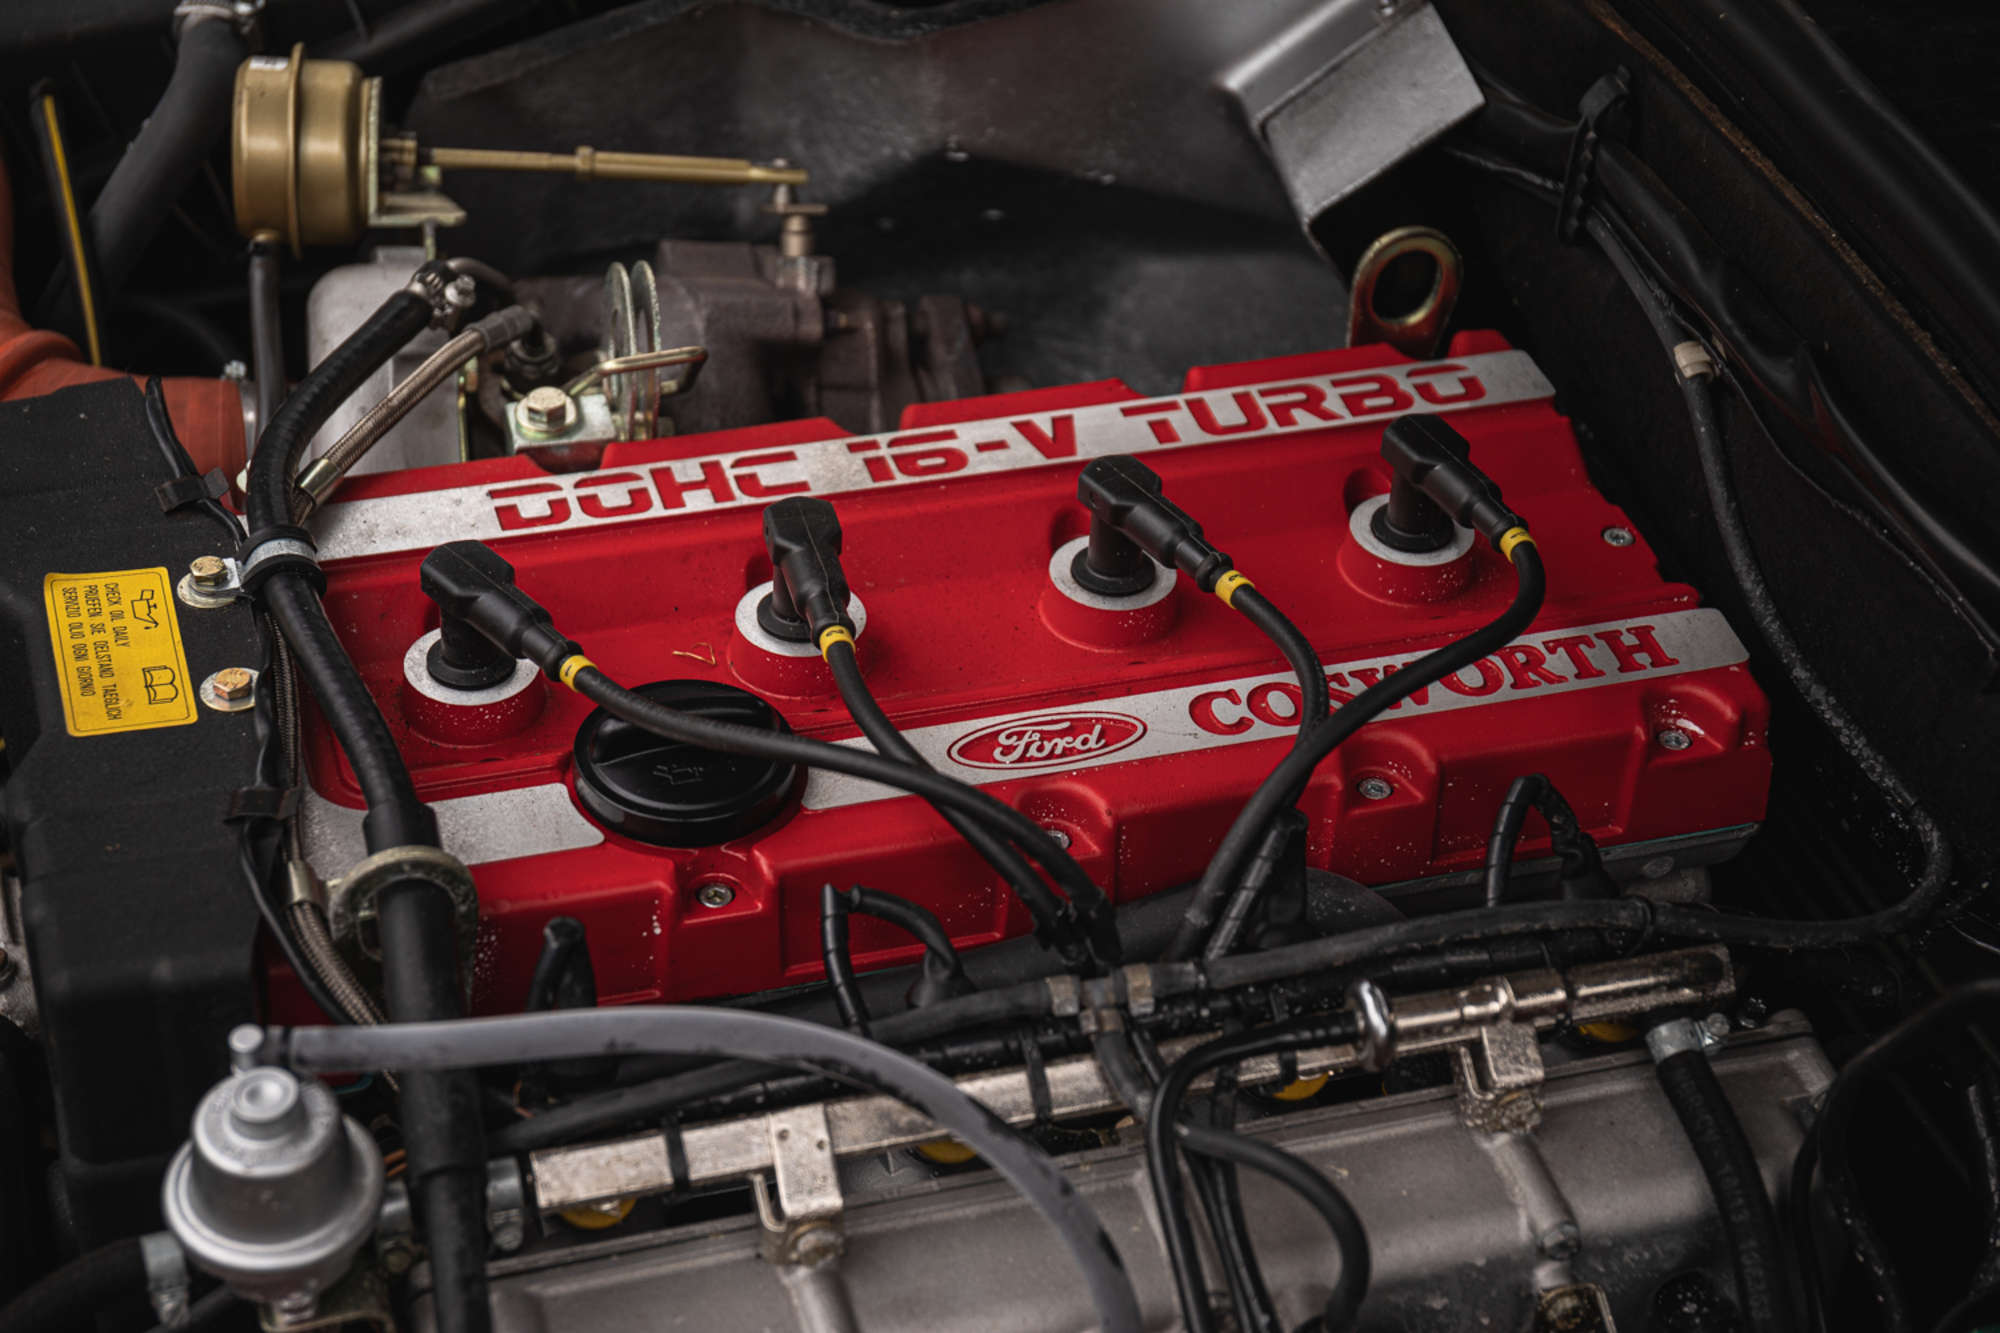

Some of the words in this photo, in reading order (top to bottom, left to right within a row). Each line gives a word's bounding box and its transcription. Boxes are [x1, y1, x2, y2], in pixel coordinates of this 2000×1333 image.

[488, 451, 811, 531] DOHC
[847, 414, 1078, 482] 16-V
[1119, 364, 1486, 446] TURBO
[62, 586, 81, 618] SERVIZIO
[84, 584, 102, 618] PRUEFEN
[104, 582, 122, 607] CHECK
[90, 623, 106, 636] SIE
[109, 609, 126, 622] OIL
[68, 621, 86, 640] OLIO
[112, 625, 130, 647] DAILY
[72, 643, 90, 662] OGNI
[93, 640, 115, 679] OELSTAND
[102, 684, 123, 721] TAEGLICH
[992, 721, 1106, 762] Ford
